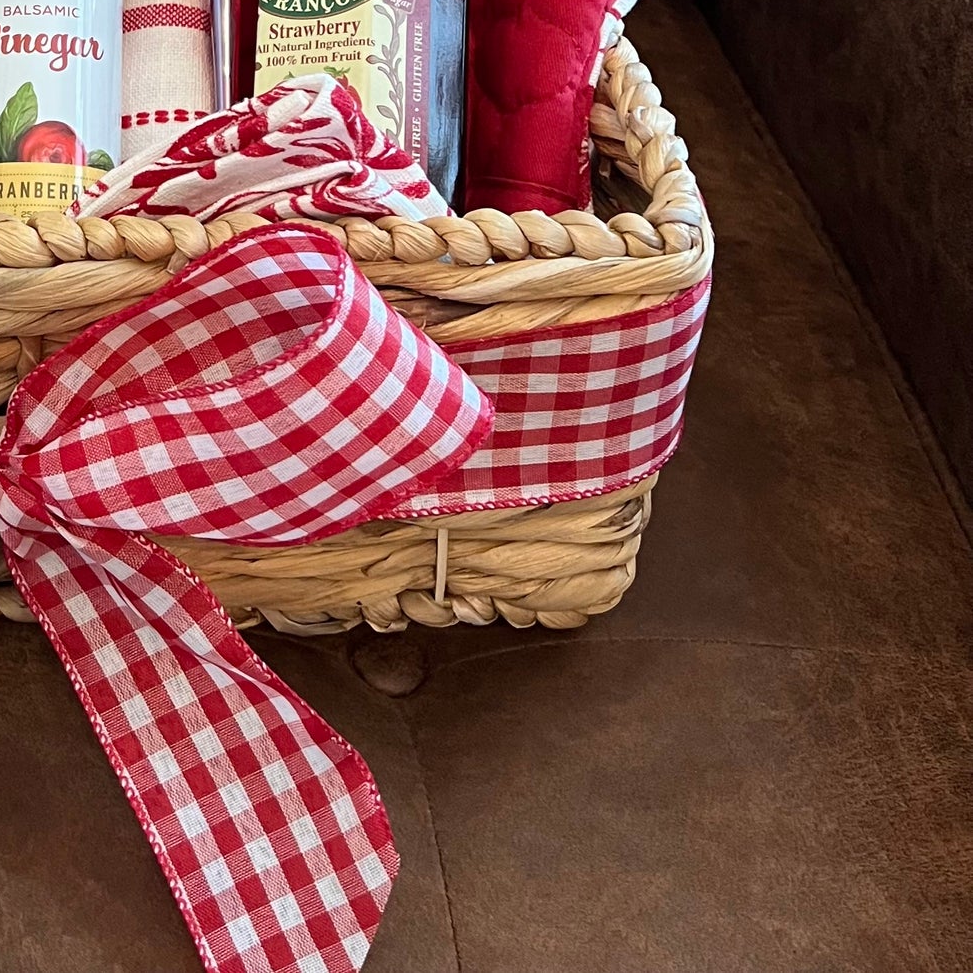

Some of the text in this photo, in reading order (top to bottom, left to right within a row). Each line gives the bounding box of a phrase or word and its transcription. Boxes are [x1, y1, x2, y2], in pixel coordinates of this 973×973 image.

[3, 5, 81, 18] BALSAMIC
[269, 20, 361, 40] Strawberry
[413, 21, 424, 52] FREE
[257, 37, 376, 54] All Natural Ingredients
[267, 50, 362, 67] 100% from Fruit
[412, 54, 423, 102] GLUTEN
[412, 116, 422, 148] FREE
